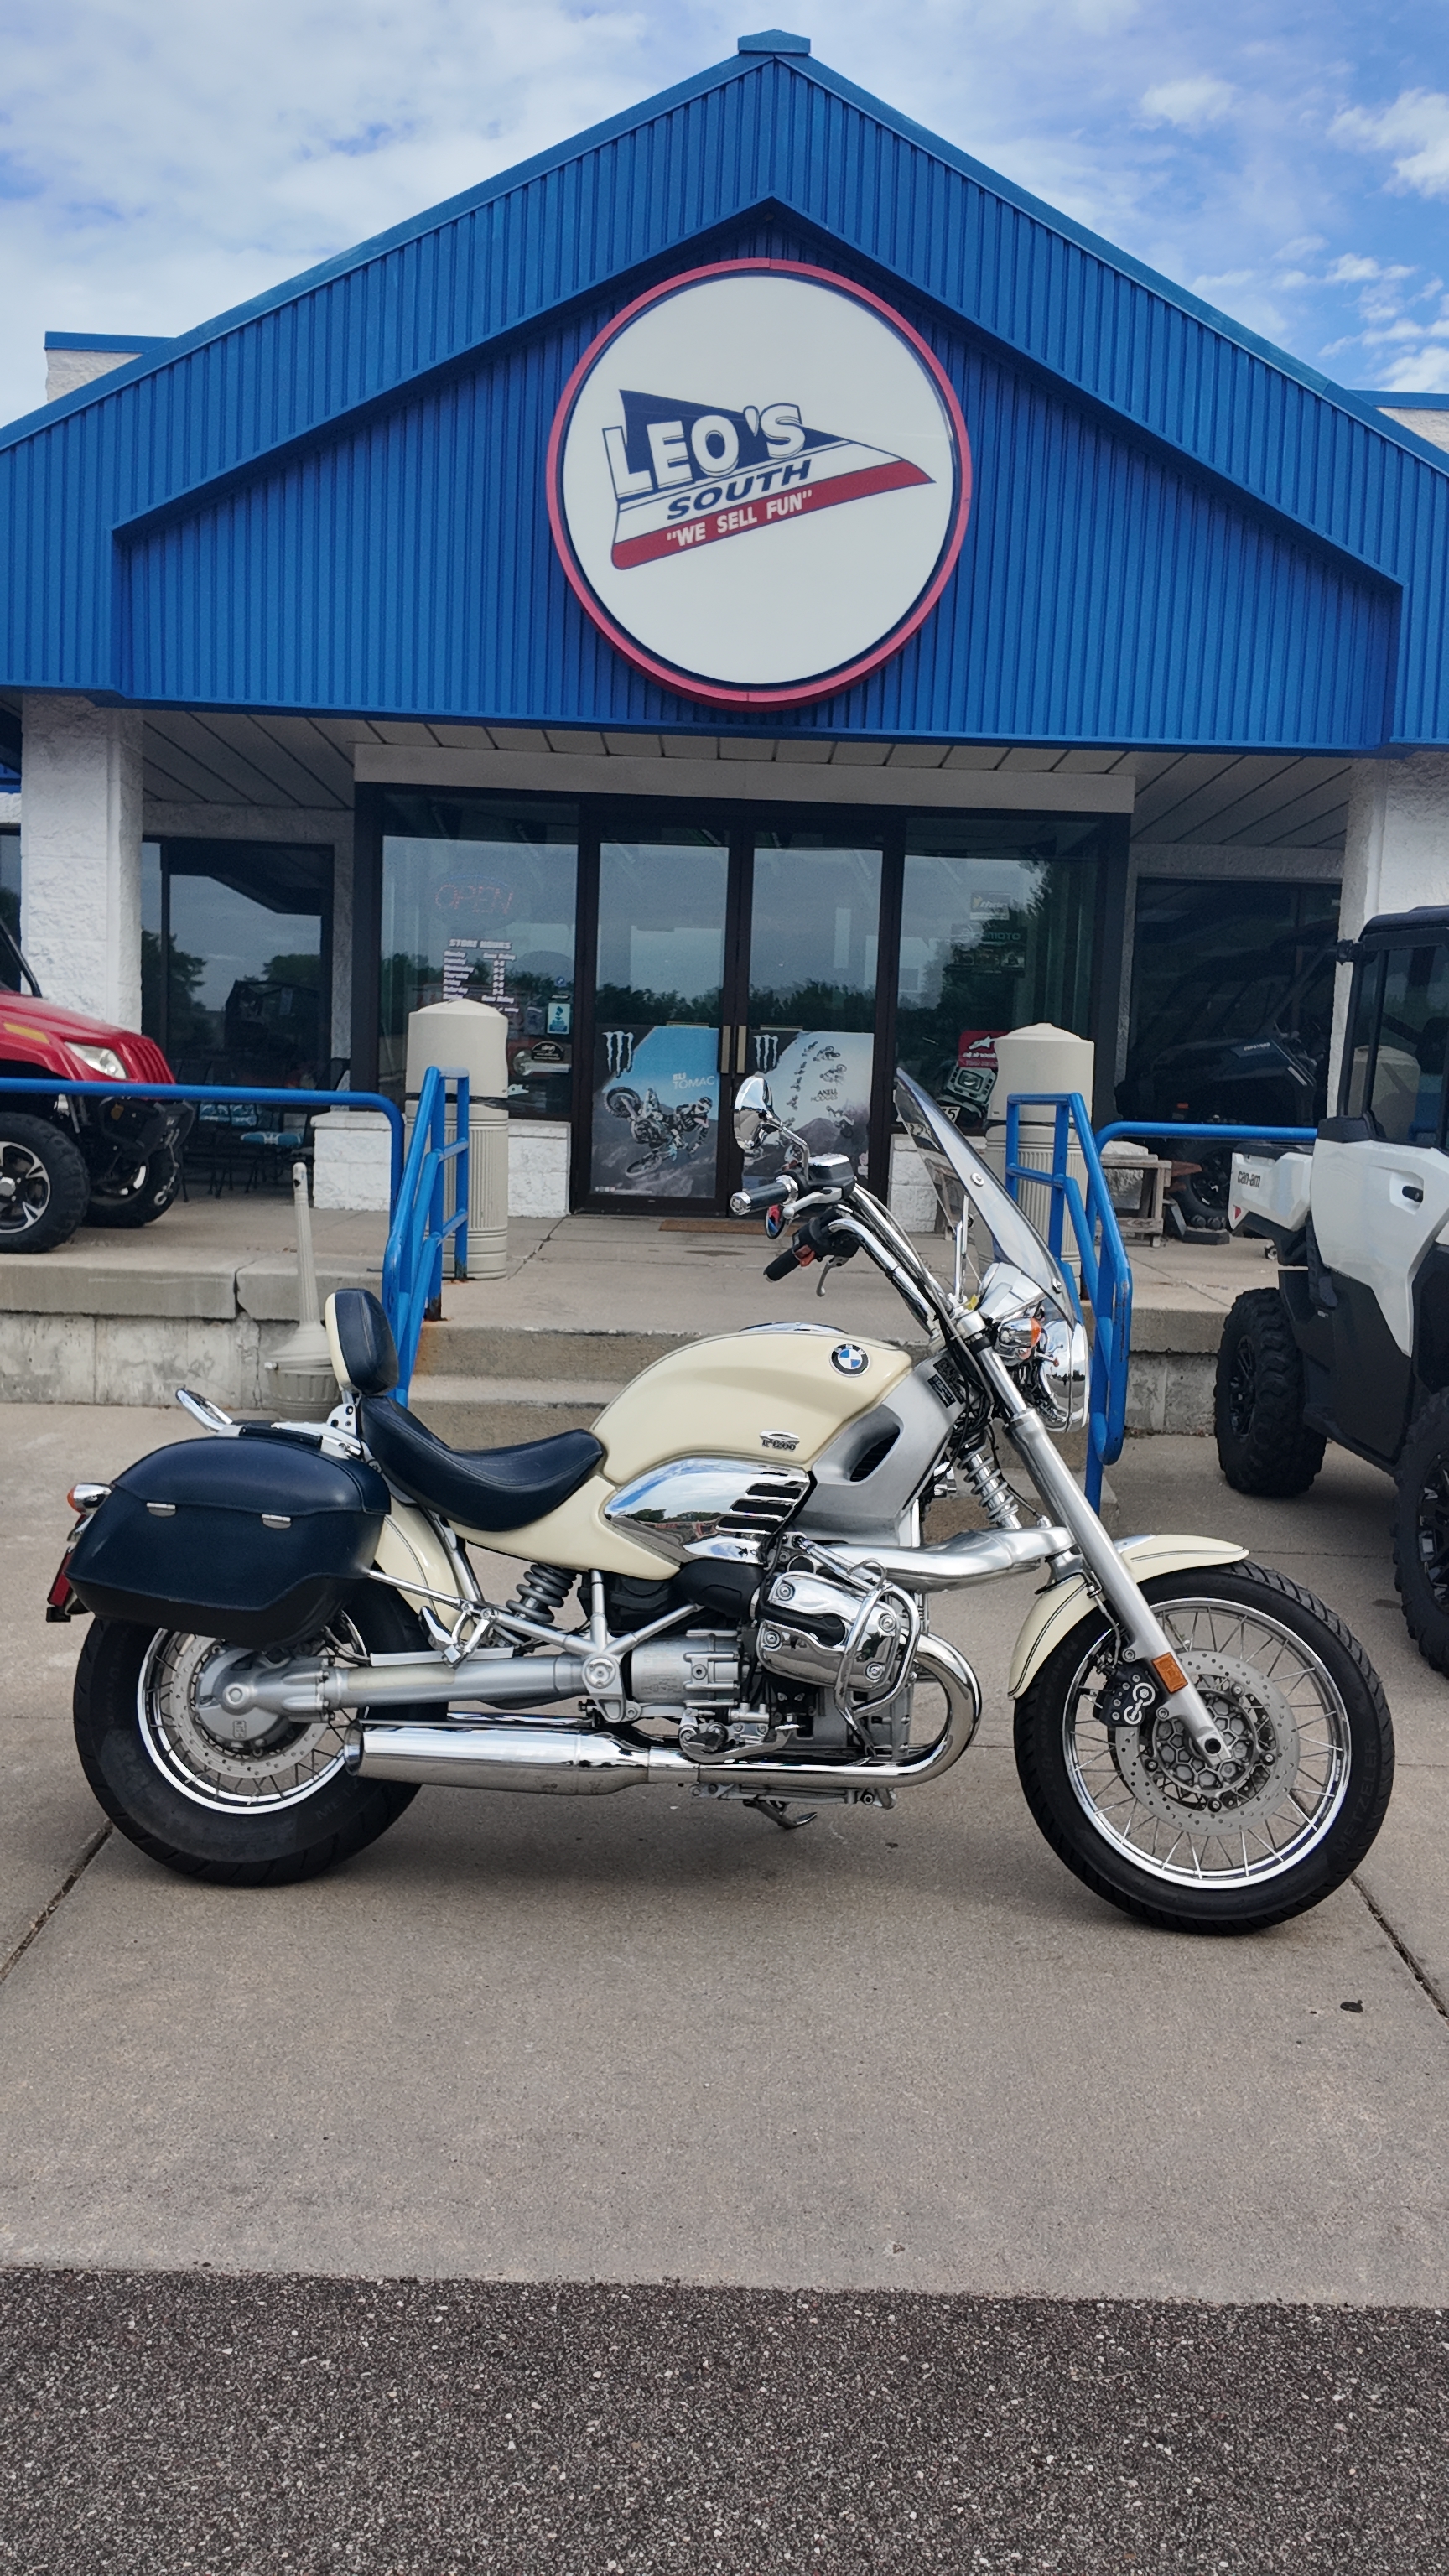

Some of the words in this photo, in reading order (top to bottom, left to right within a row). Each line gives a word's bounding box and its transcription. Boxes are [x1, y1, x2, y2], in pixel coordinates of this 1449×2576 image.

[602, 402, 806, 503] LEO'S
[667, 458, 812, 521] SOUTH
[667, 522, 706, 547] "WE
[716, 506, 757, 533] SELL
[766, 489, 812, 520] FUN"
[434, 884, 514, 915] OPEN
[449, 938, 478, 948] STORE
[673, 1075, 715, 1090] TOMAC
[1237, 1171, 1261, 1188] can-am
[1333, 1739, 1377, 1855] METZELER
